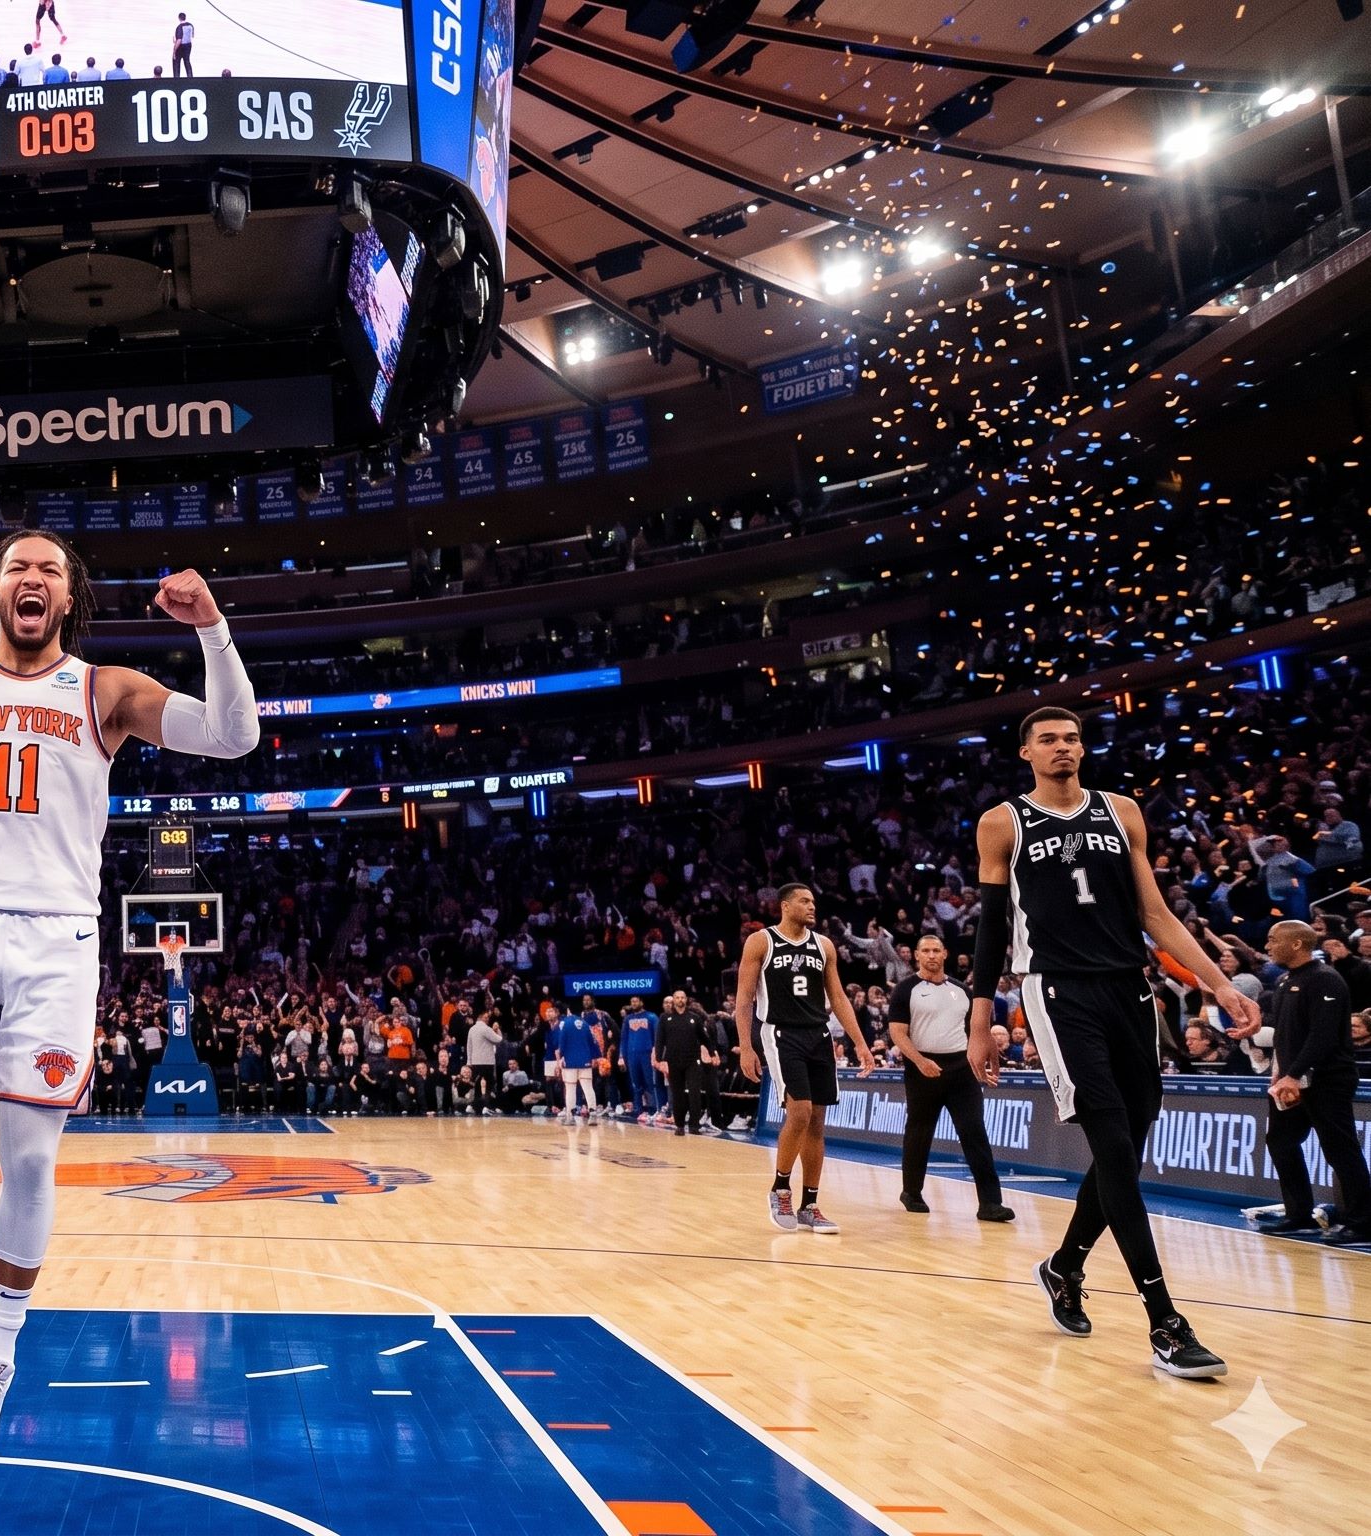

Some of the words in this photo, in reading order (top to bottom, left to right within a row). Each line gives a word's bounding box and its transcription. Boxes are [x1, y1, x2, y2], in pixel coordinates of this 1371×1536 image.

[6, 93, 35, 112] 4TH
[37, 85, 104, 110] QUARTER
[131, 88, 209, 144] 108
[237, 90, 314, 141] SAS
[19, 110, 96, 158] 0:03
[460, 684, 506, 702] KNICKS
[507, 679, 536, 697] WIN!
[284, 699, 312, 715] WIN!
[14, 705, 83, 747] YORK
[509, 771, 566, 789] QUARTER
[124, 798, 152, 813] 112
[1070, 867, 1097, 905] 1
[792, 975, 808, 996] 2
[1152, 1109, 1257, 1178] QUARTER
